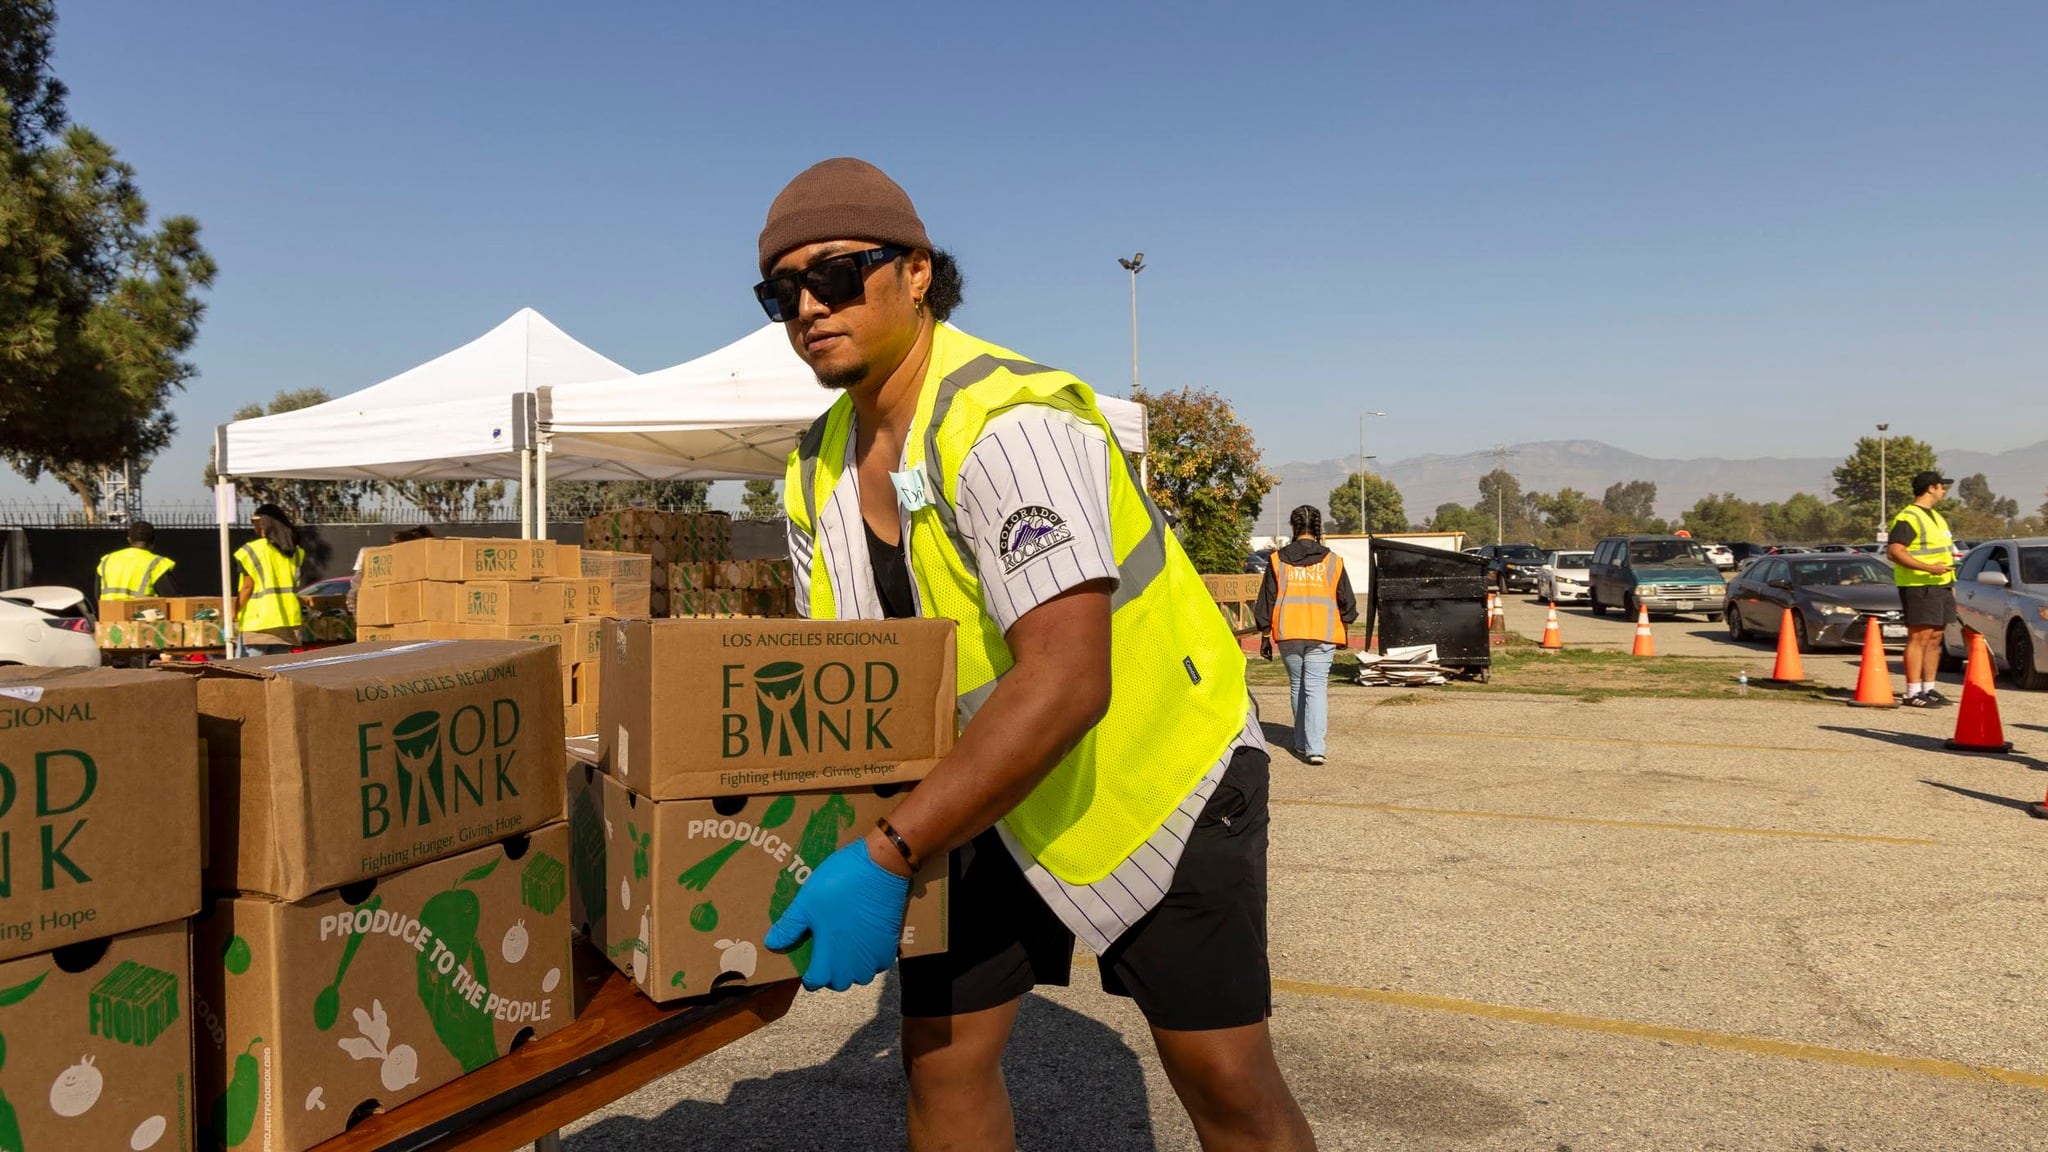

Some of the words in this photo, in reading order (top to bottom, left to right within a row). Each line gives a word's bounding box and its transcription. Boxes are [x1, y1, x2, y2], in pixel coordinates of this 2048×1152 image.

[1000, 507, 1059, 549] COLORADO
[1001, 524, 1072, 571] ROCKIES
[475, 548, 518, 560] FOOD
[475, 560, 518, 572] BANK
[722, 633, 752, 647] LOS
[756, 632, 822, 647] ANGELES
[826, 632, 899, 646] REGIONAL
[355, 685, 389, 703] LOS
[392, 675, 456, 698] ANGELES
[457, 663, 518, 687] REGIONAL
[722, 661, 899, 708] FOOD
[0, 702, 97, 730] GIONAL
[722, 707, 893, 758] BANK
[358, 698, 520, 779] FOOD
[360, 750, 520, 839] BANK
[720, 771, 769, 788] Fighting
[822, 765, 861, 779] Giving
[864, 763, 895, 776] Hope
[361, 849, 411, 876] Fighting
[458, 822, 493, 843] Giving
[496, 812, 522, 834] Hope
[687, 819, 792, 863] PRODUCE
[786, 854, 813, 885] TO
[0, 921, 33, 941] ing
[40, 907, 97, 931] Hope
[320, 908, 433, 953] PRODUCE
[428, 937, 456, 975] TO
[451, 964, 487, 1009] THE
[482, 992, 552, 1023] PEOPLE
